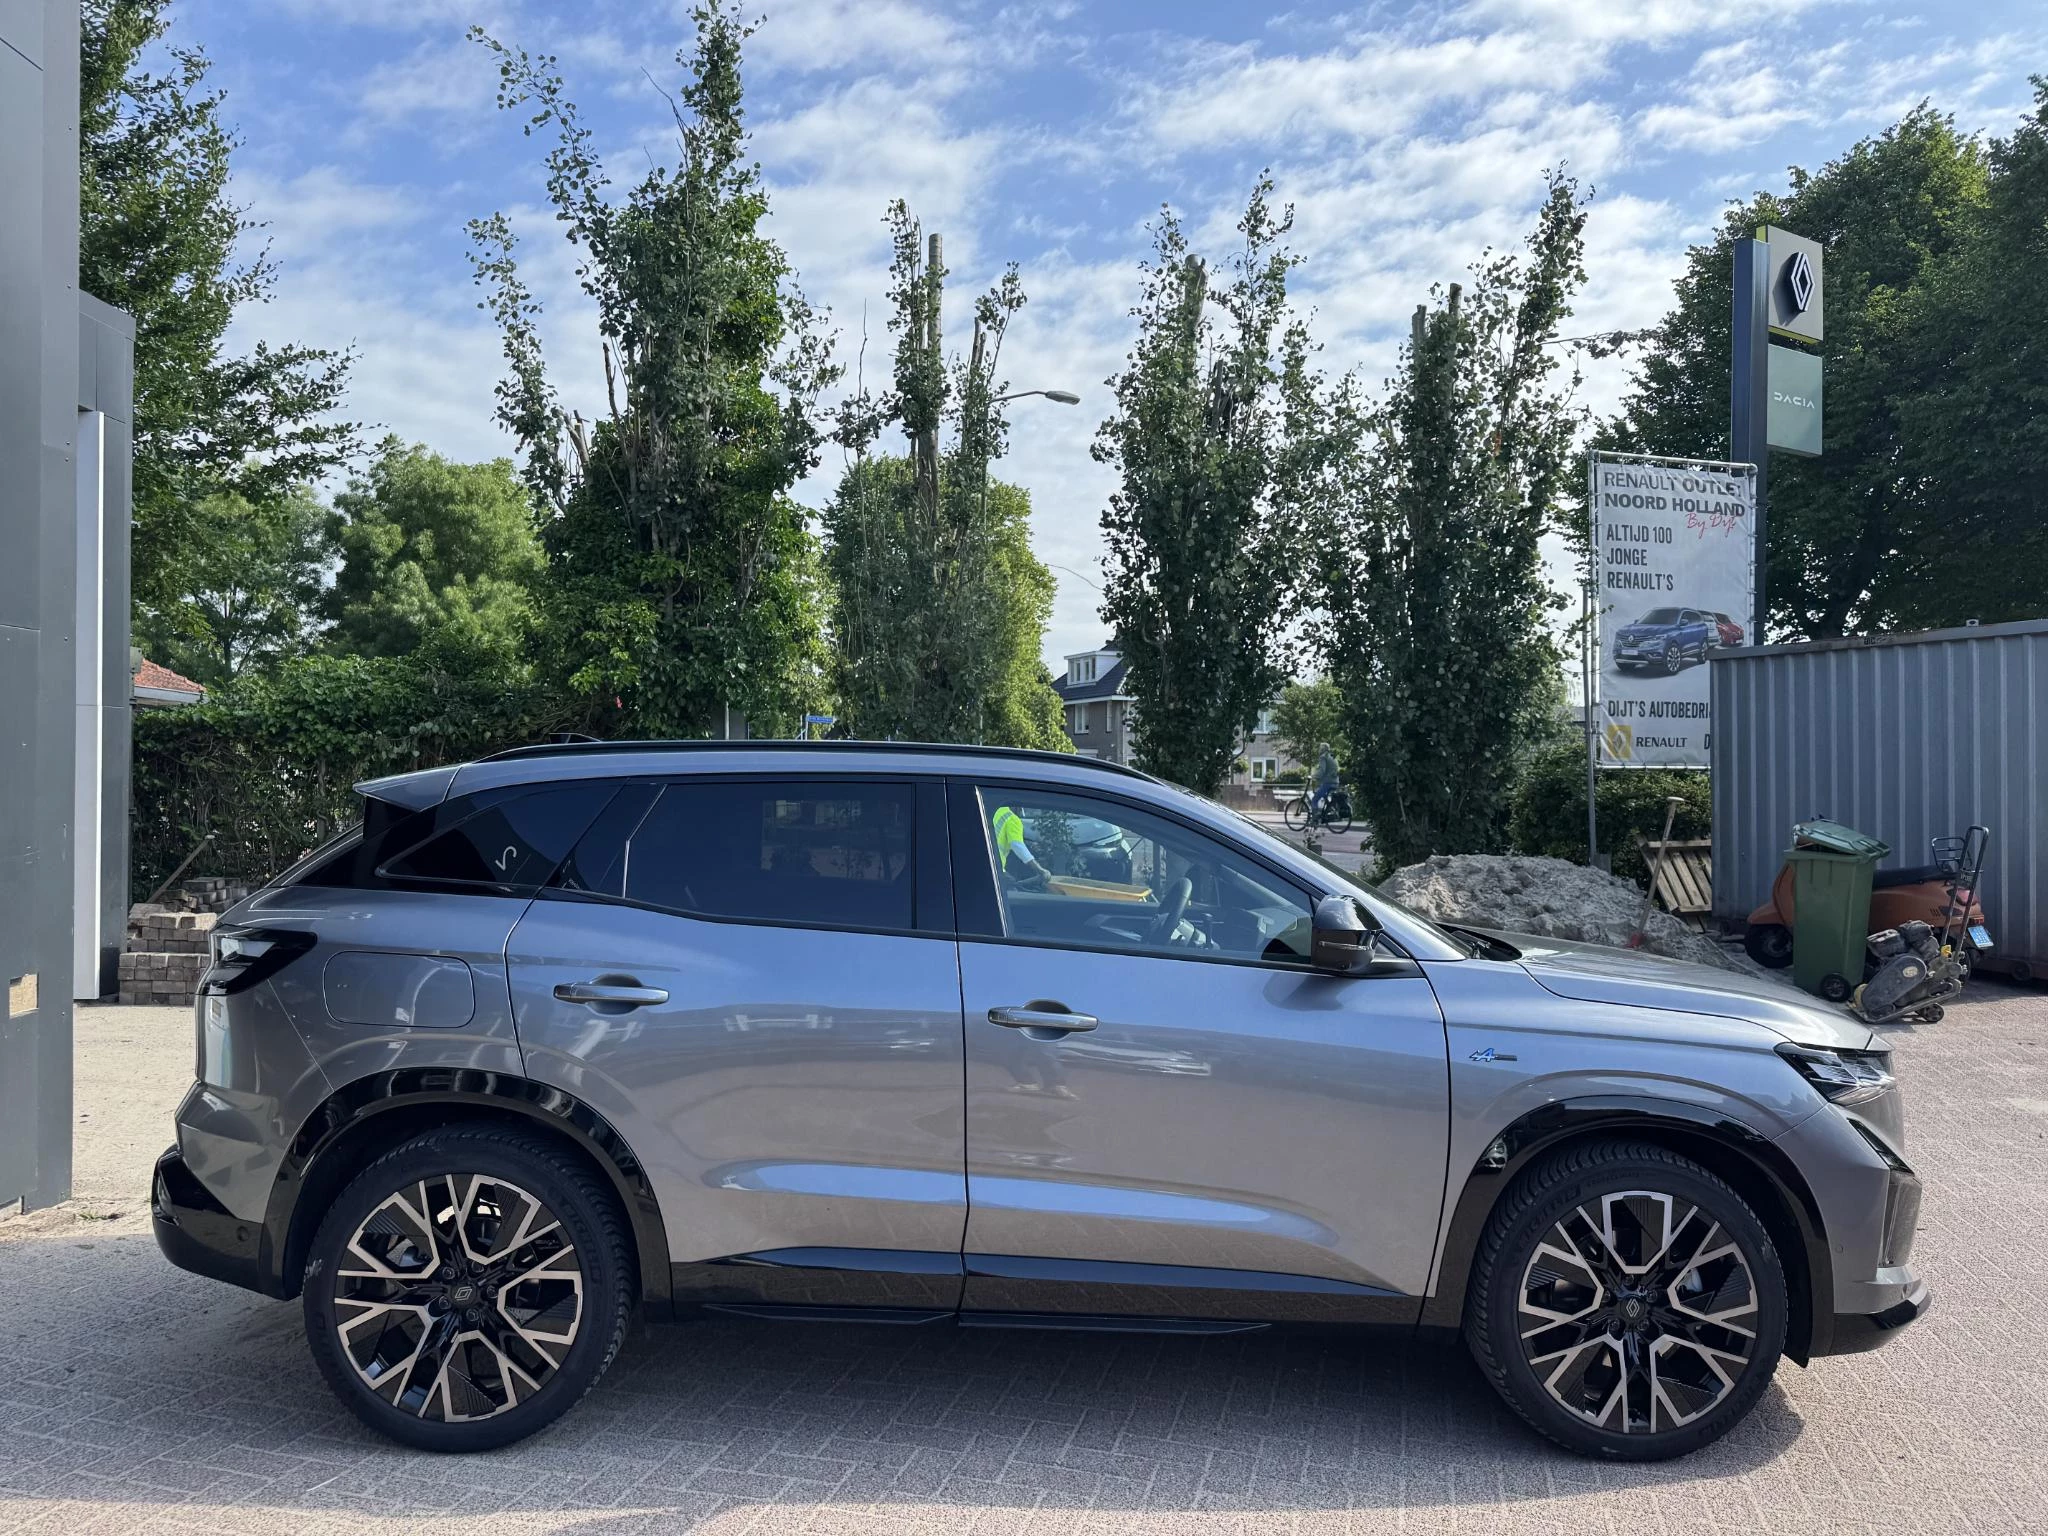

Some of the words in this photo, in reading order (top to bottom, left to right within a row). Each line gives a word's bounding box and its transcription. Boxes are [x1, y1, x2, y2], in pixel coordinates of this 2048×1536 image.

[1773, 391, 1815, 409] DACIA
[1604, 471, 1678, 491] RENAULT
[1604, 493, 1667, 510] NOORD
[1672, 498, 1746, 517] HOLLAND
[1606, 523, 1650, 543] ALTIJD
[1652, 526, 1673, 545] 100
[1686, 512, 1708, 539] By
[1606, 547, 1648, 567] JONGE
[1607, 571, 1674, 591] RENAULT'S
[1608, 700, 1646, 718] DIJT'S
[1648, 701, 1711, 719] AUTOBEDRI
[1635, 736, 1688, 748] RENAULT
